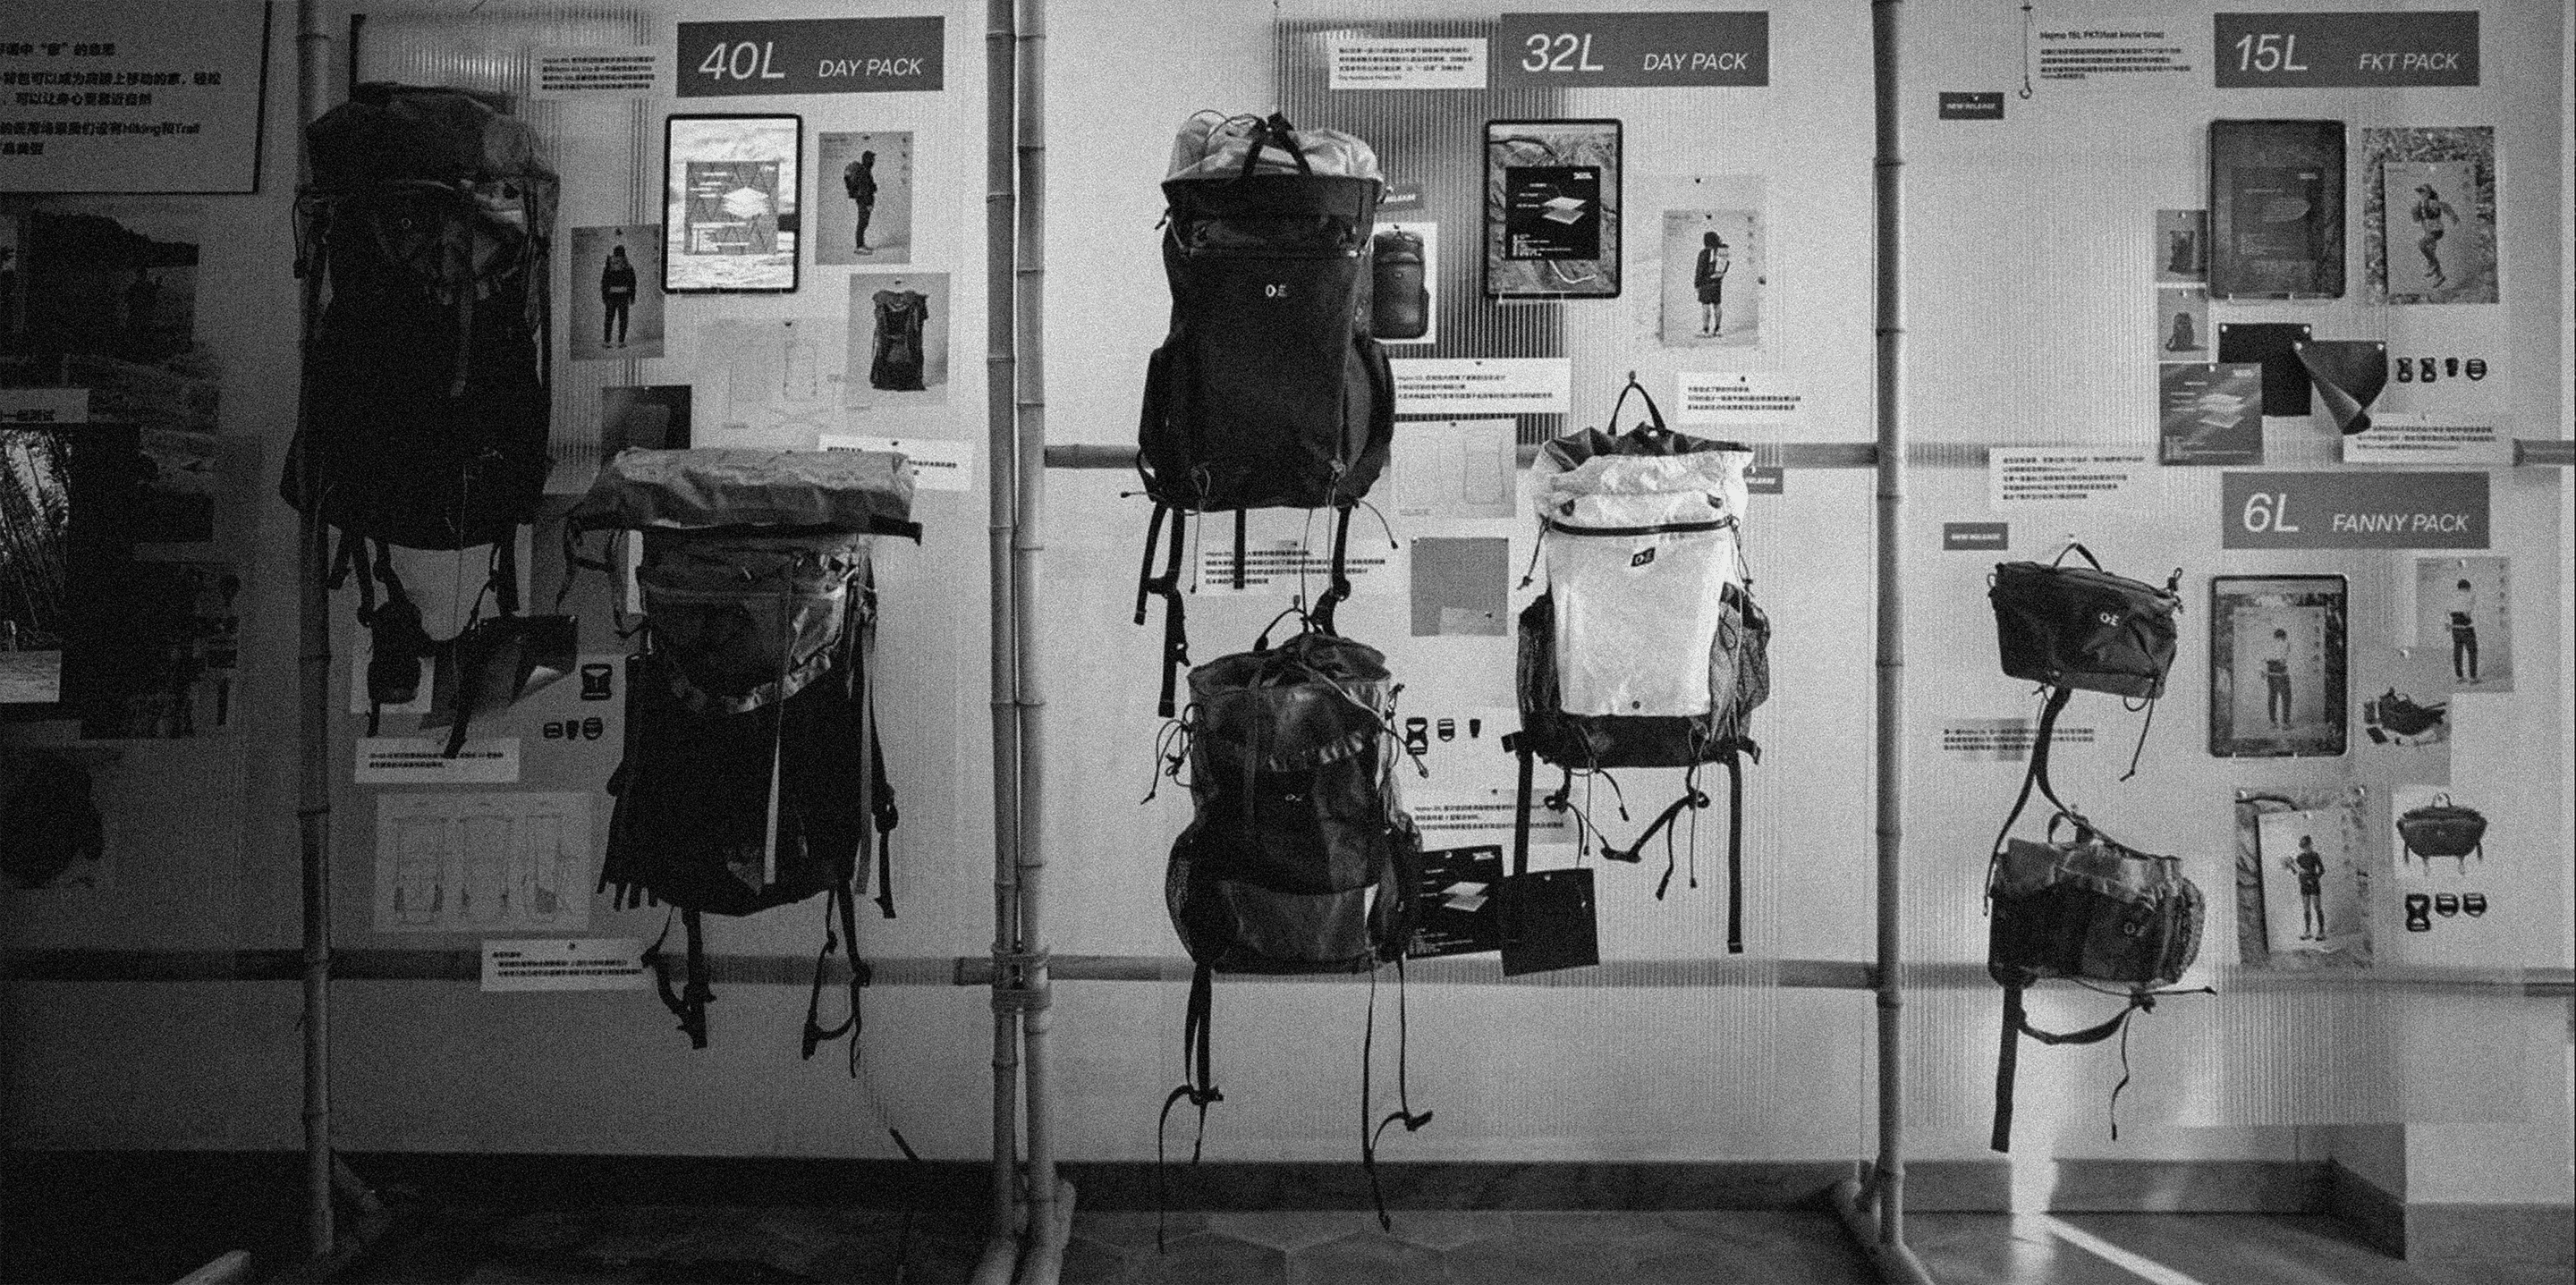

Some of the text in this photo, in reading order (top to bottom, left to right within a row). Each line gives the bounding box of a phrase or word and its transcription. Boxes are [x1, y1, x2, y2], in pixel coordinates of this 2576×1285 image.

[699, 41, 923, 80] 40L DAY PACK
[1521, 33, 1749, 72] 32L DAY PACK
[2235, 34, 2460, 72] 15L FKT PACK
[2242, 492, 2469, 533] 6L FANNY PACK
